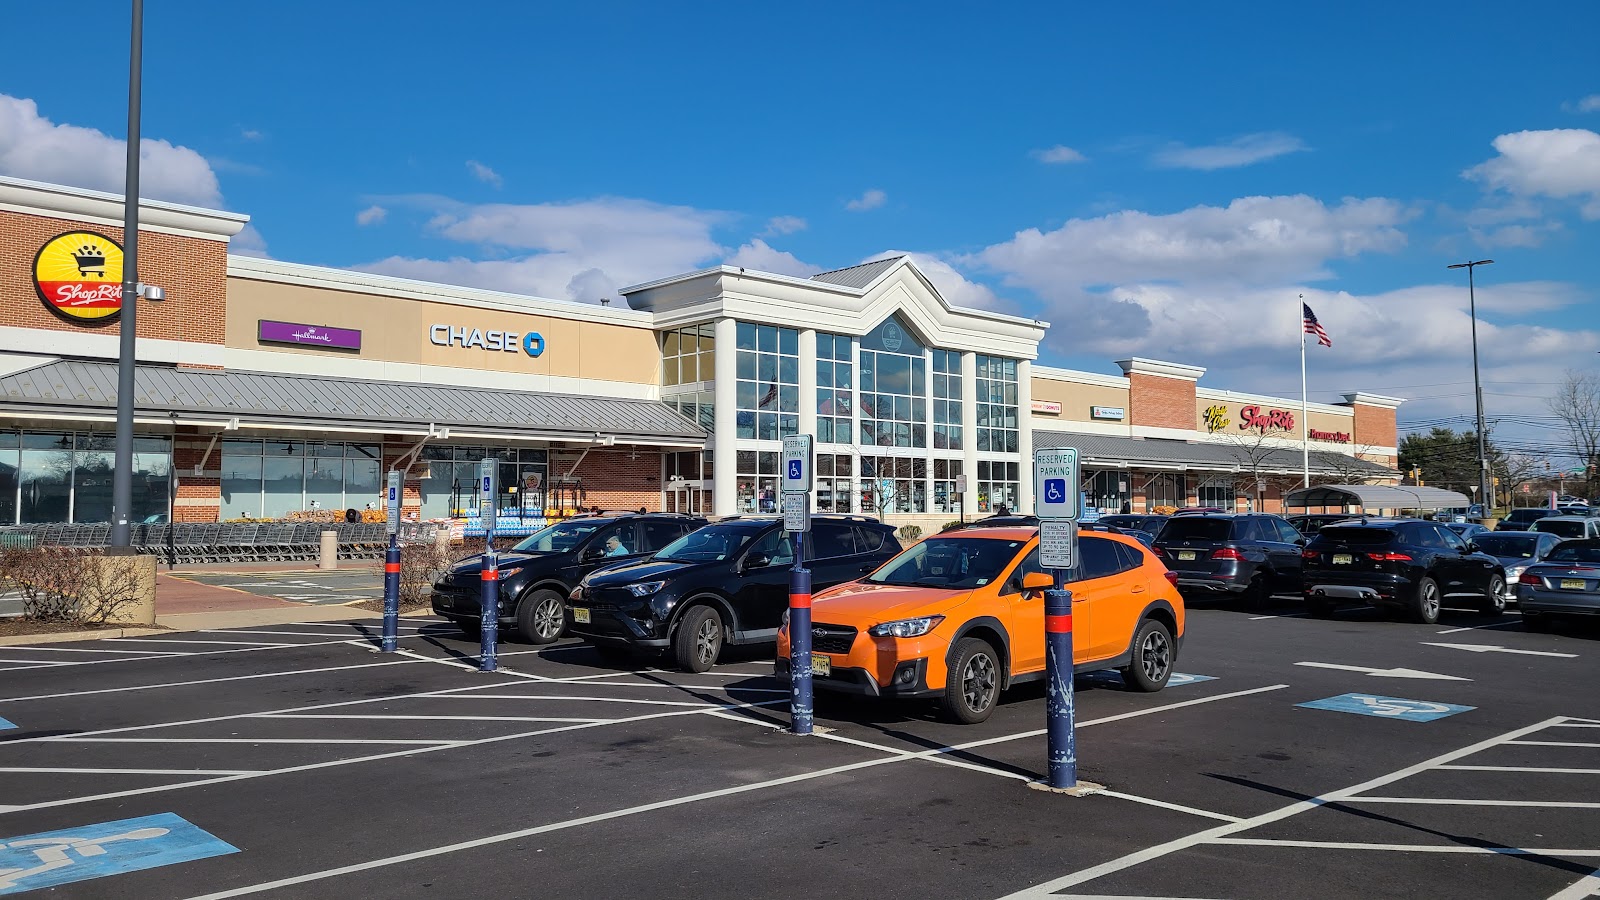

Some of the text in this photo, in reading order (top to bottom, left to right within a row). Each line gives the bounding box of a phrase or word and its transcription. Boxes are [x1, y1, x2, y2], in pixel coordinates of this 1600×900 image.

[291, 330, 332, 342] Hallmark
[430, 323, 519, 353] CHASE
[1240, 405, 1295, 433] ShopRite
[785, 440, 806, 448] RESERVED
[786, 449, 805, 458] PARKING
[1038, 454, 1073, 464] RESERVED
[1040, 466, 1070, 476] PARKING
